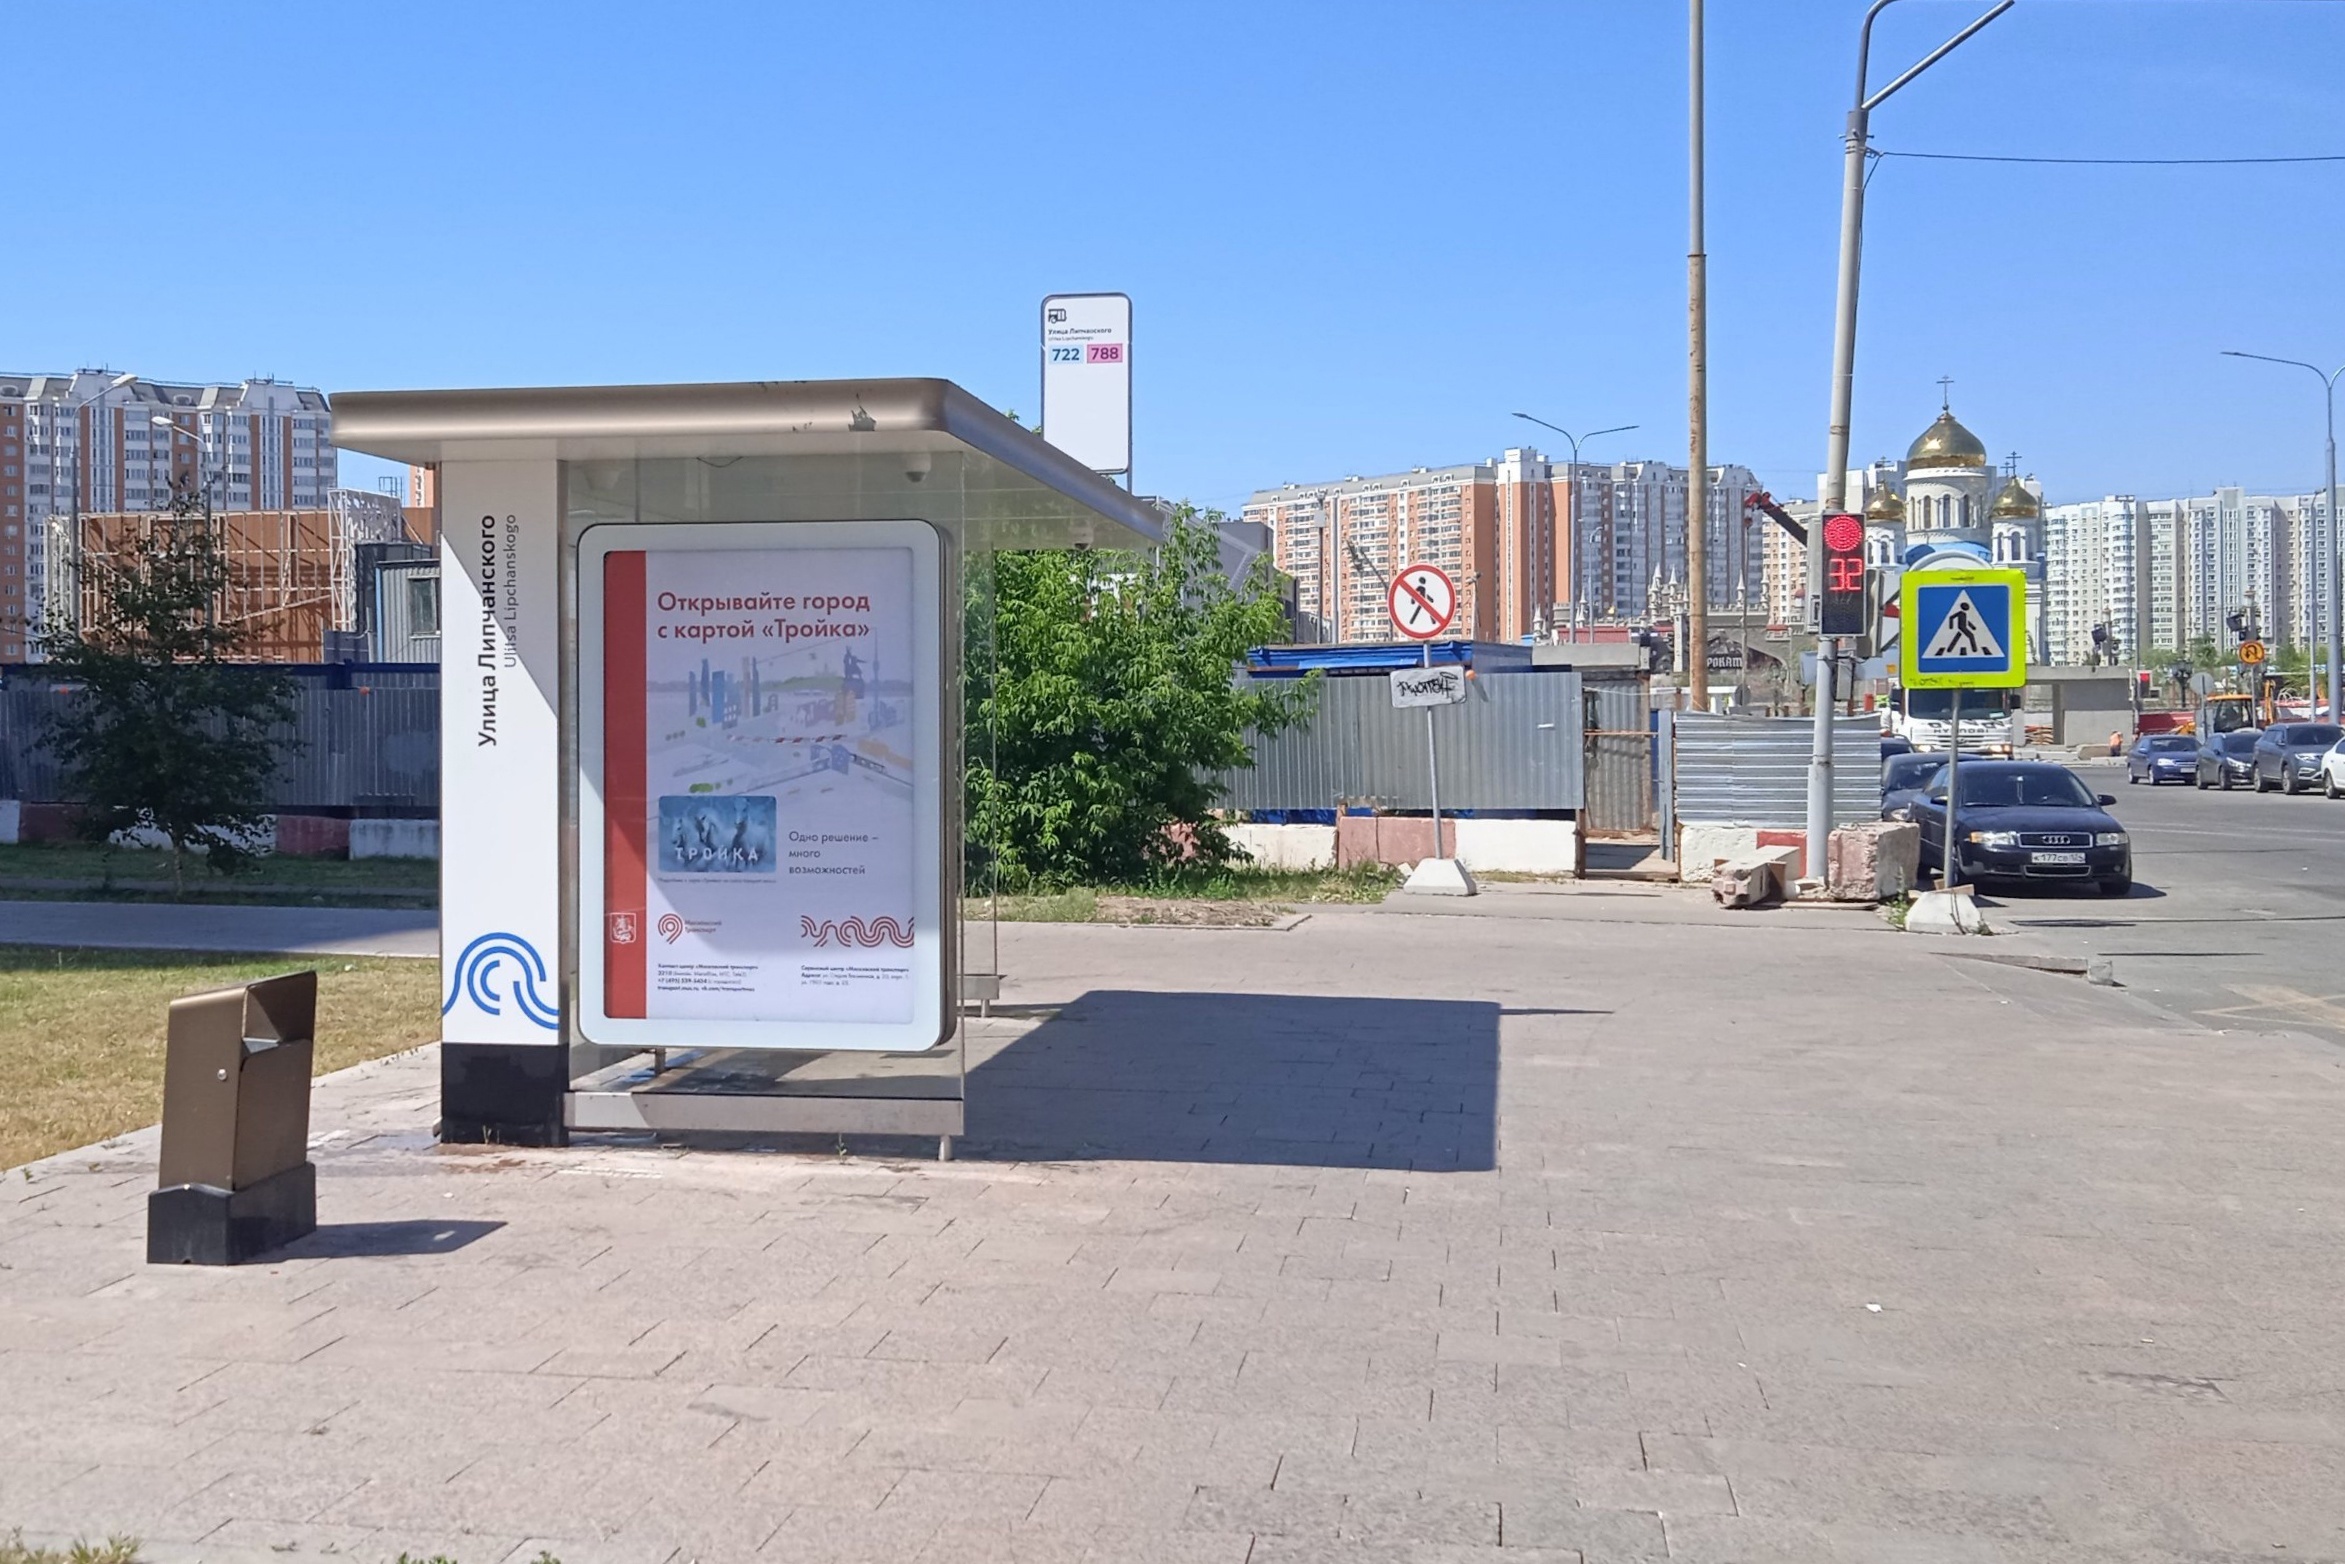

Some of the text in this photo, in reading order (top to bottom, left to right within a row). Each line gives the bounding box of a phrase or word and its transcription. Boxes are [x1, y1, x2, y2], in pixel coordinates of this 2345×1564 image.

[1052, 348, 1080, 361] 722
[1091, 347, 1119, 360] 788
[1829, 558, 1862, 591] 32
[503, 514, 519, 668] Ulitsa Lipchanskogo
[658, 591, 870, 617] Открывайте город
[478, 514, 499, 747] Улица Липчанского
[657, 618, 870, 644] с картой «Тройка»
[1706, 656, 1743, 668] РОКАТ
[789, 831, 818, 842] Одно
[821, 834, 869, 844] решение
[674, 844, 759, 861] ТРОЙКА
[788, 850, 821, 858] много
[789, 864, 866, 875] возможностей
